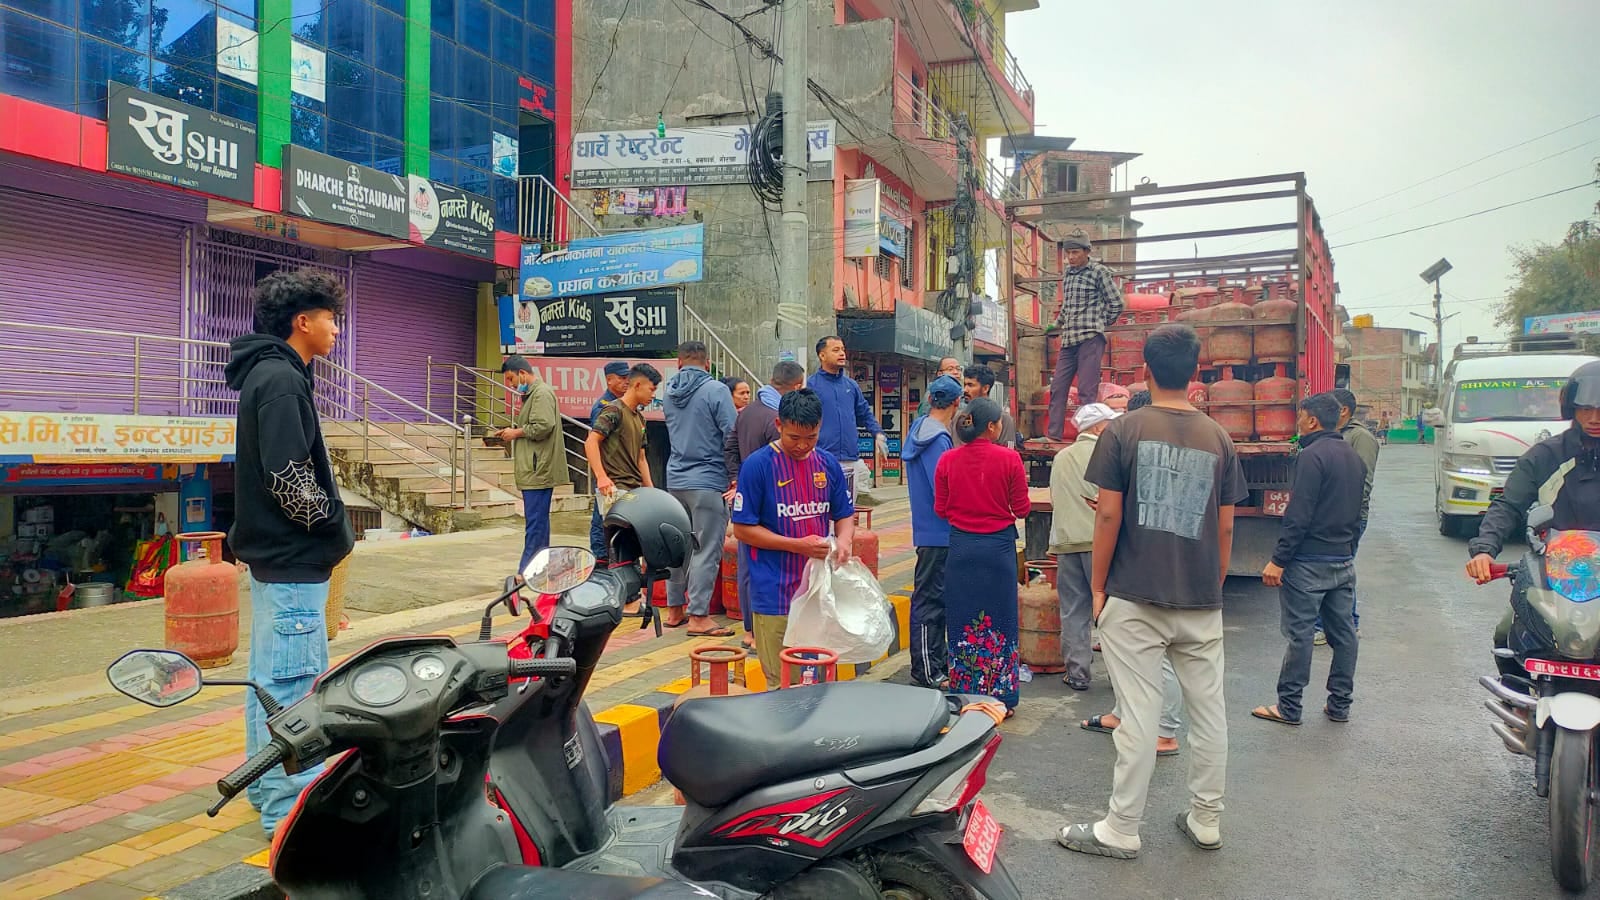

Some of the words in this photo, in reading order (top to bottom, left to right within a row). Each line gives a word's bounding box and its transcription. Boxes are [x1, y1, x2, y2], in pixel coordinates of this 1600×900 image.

[576, 131, 611, 159] धार्चे
[296, 168, 344, 198] DHARCHE
[346, 182, 406, 214] RESTAURANT
[440, 194, 468, 219] नमस्ते
[470, 200, 495, 232] Kids
[557, 277, 594, 296] प्रधान
[597, 269, 660, 291] कार्यालय
[539, 299, 565, 324] नमस्ते
[568, 298, 592, 324] Kids
[1461, 381, 1517, 390] SHIVANI
[114, 421, 235, 448] इन्टरप्राईजे
[777, 501, 830, 518] Rakuten
